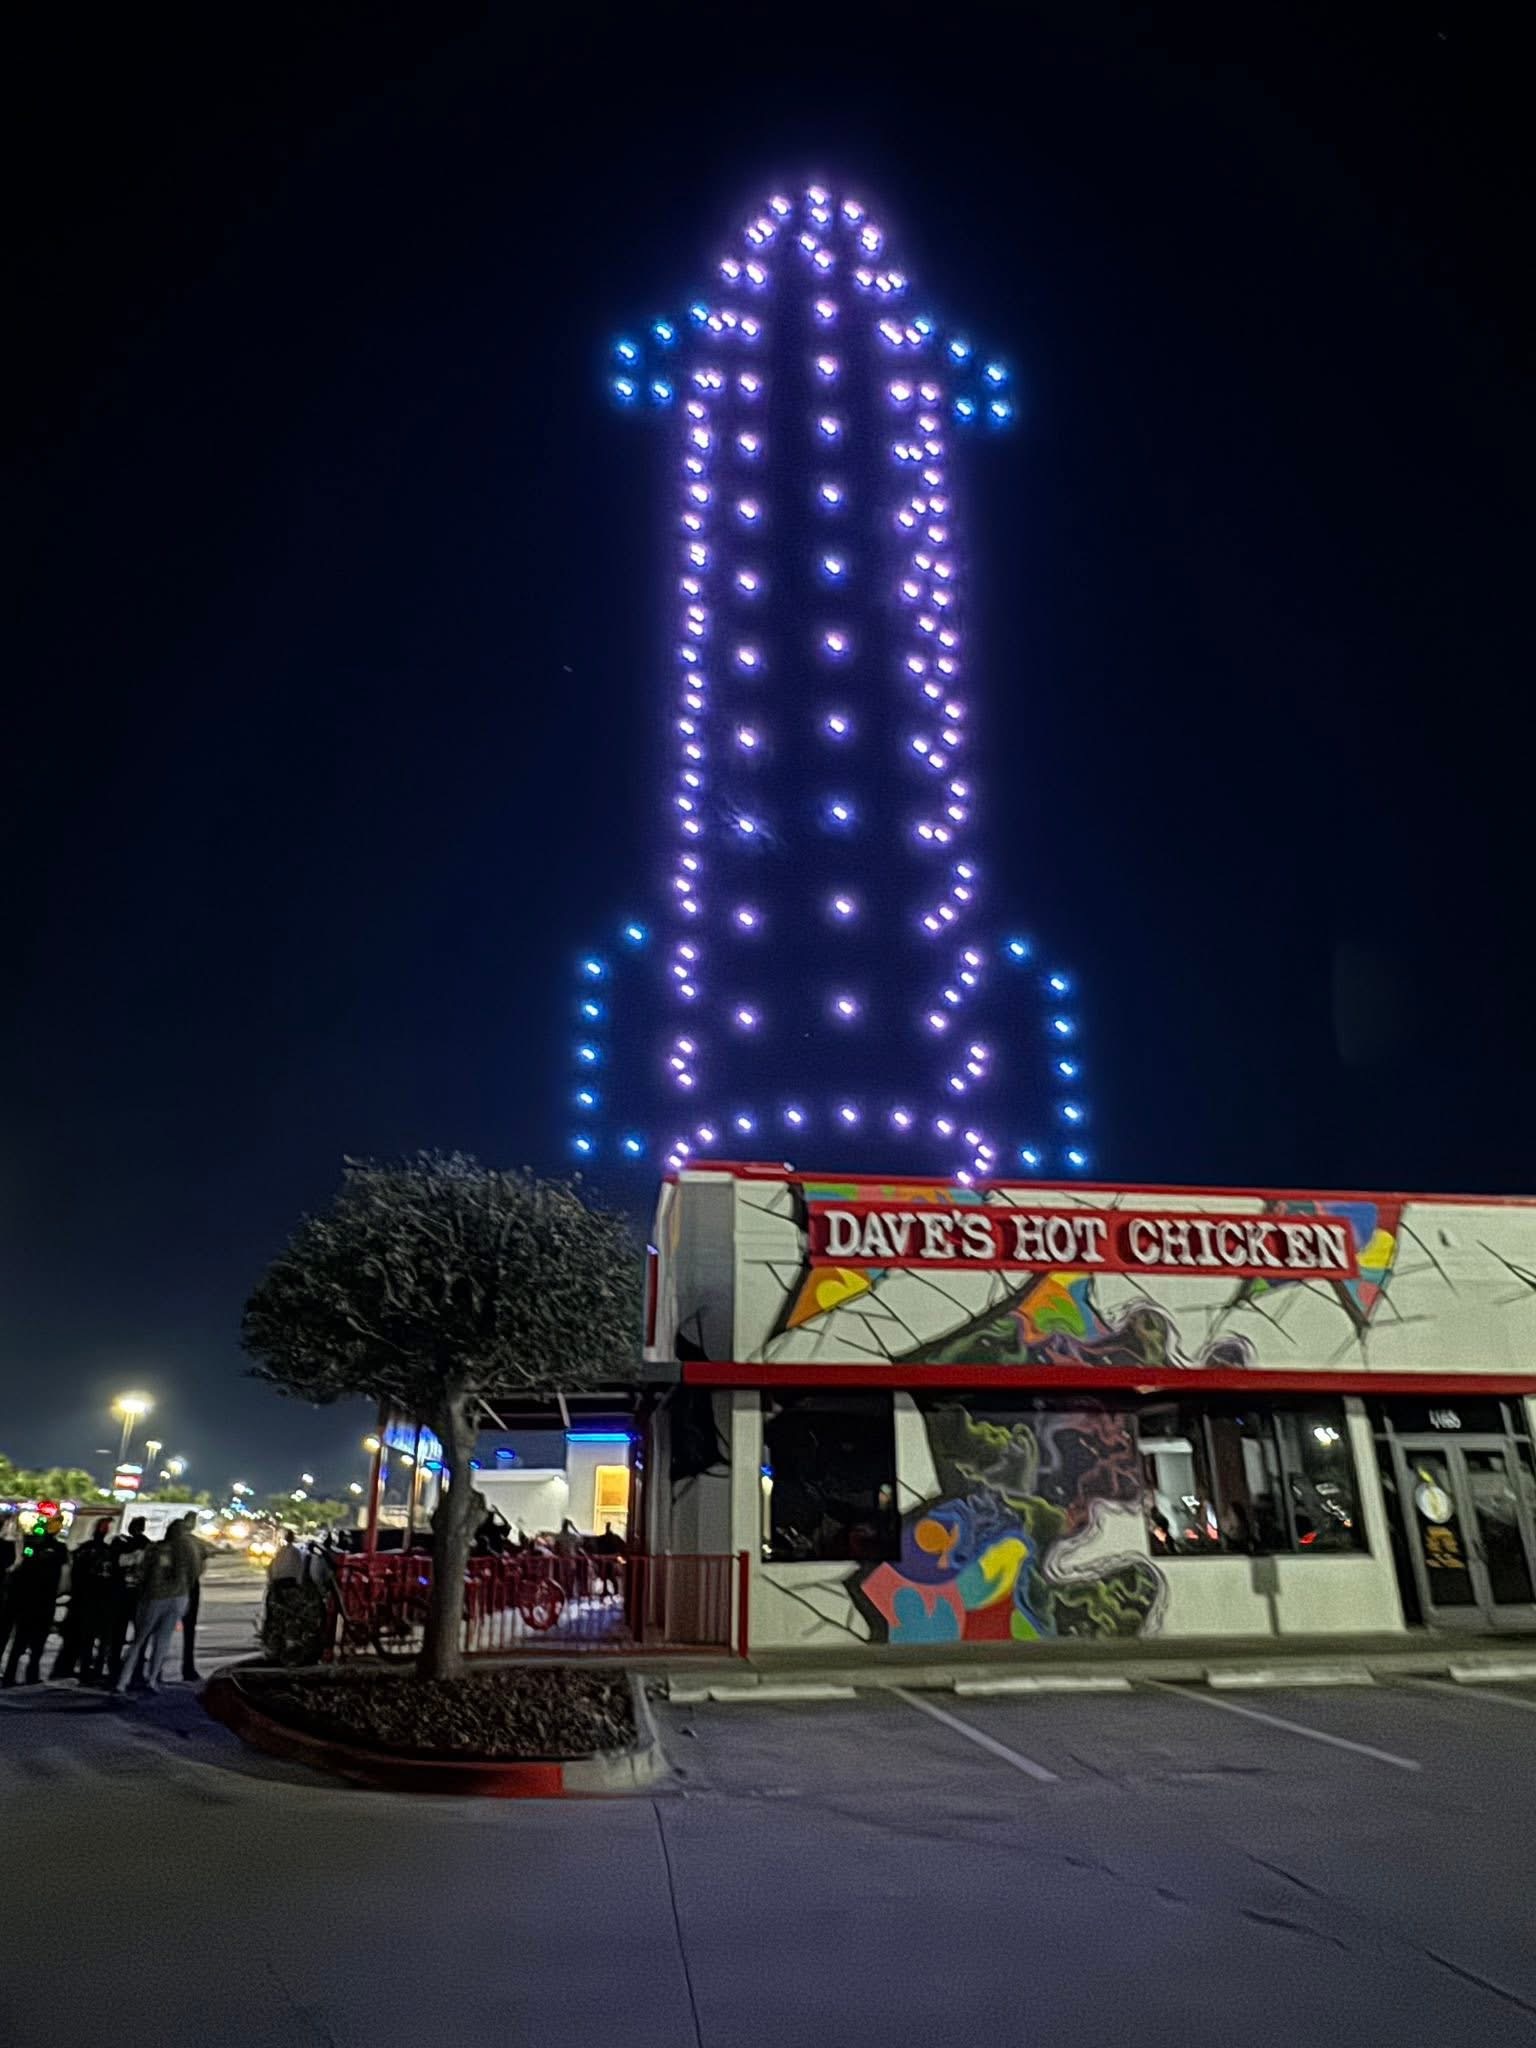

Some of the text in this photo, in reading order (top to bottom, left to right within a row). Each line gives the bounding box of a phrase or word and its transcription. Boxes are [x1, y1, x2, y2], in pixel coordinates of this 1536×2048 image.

[824, 1209, 1349, 1270] DAVE'S HOT CHICKEN
